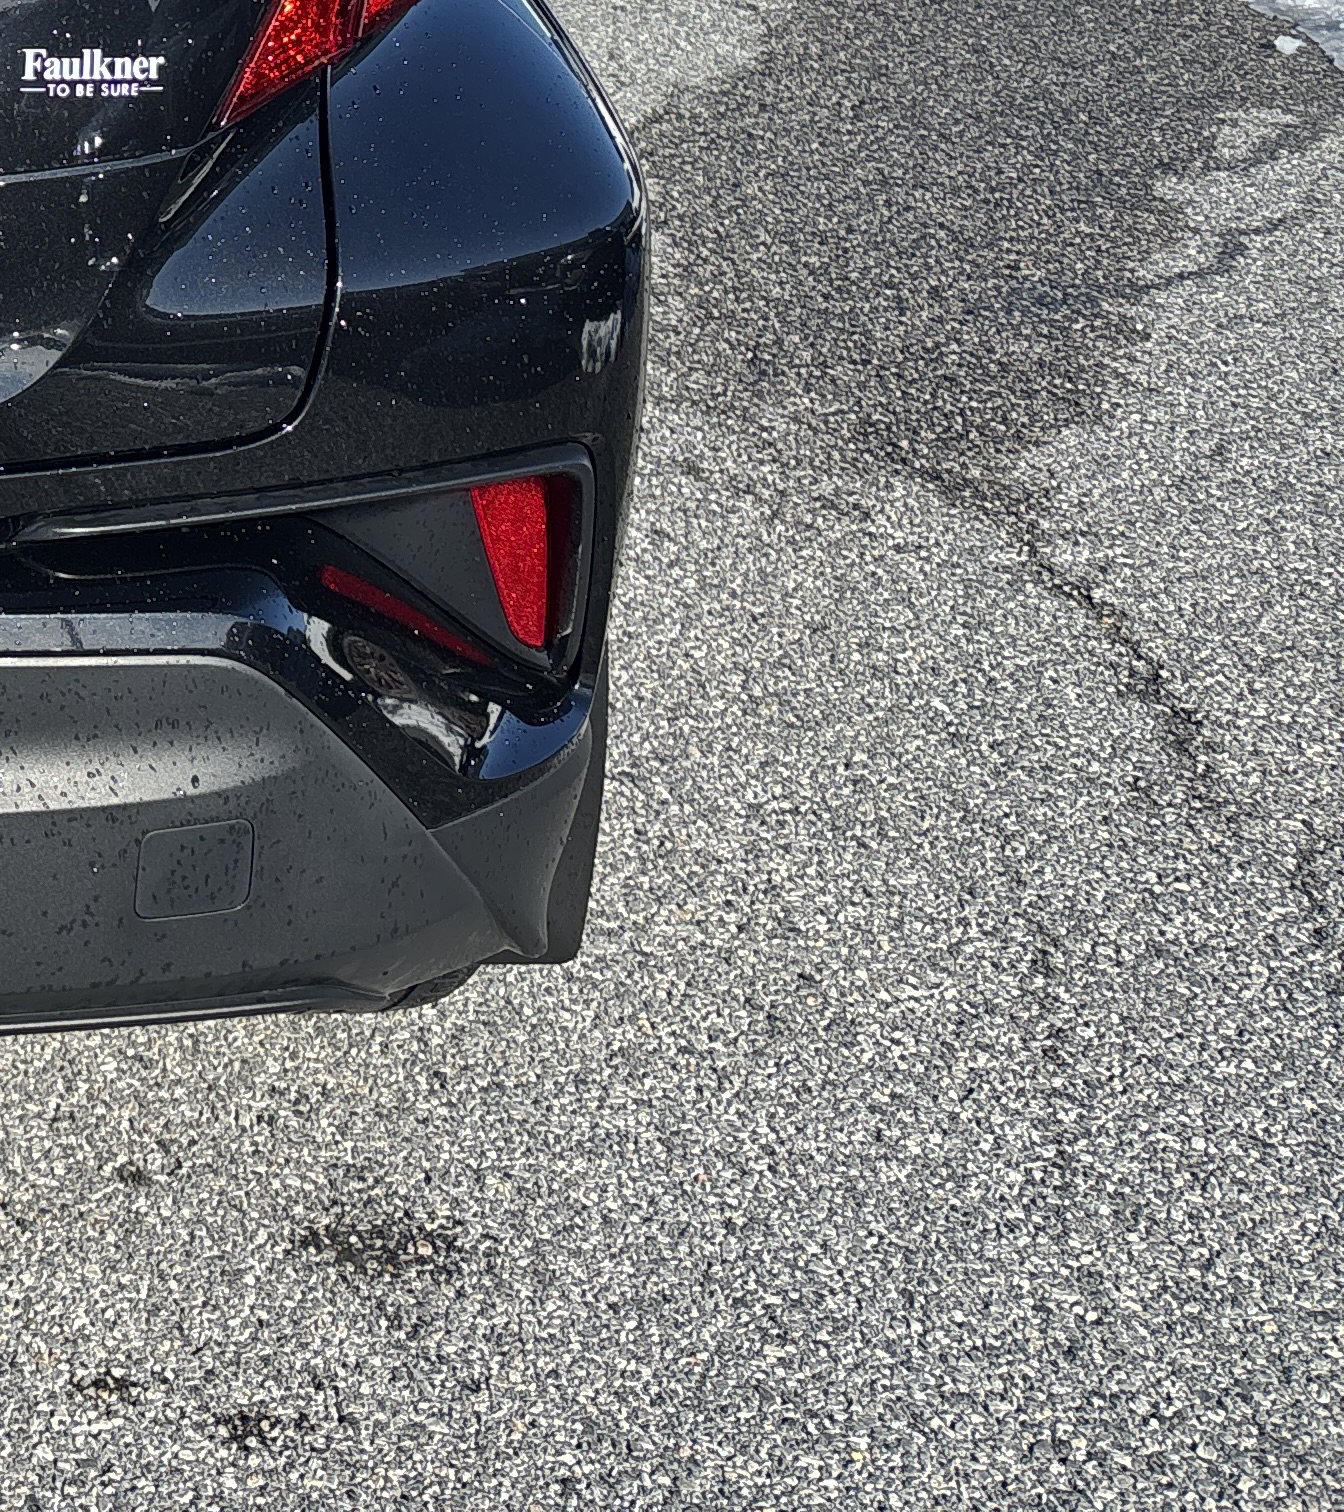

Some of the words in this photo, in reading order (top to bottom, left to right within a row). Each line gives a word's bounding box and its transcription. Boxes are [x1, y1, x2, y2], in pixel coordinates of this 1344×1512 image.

[20, 48, 165, 80] Faulkner
[47, 83, 70, 97] TO
[75, 83, 94, 97] BE
[100, 82, 139, 97] SURE
